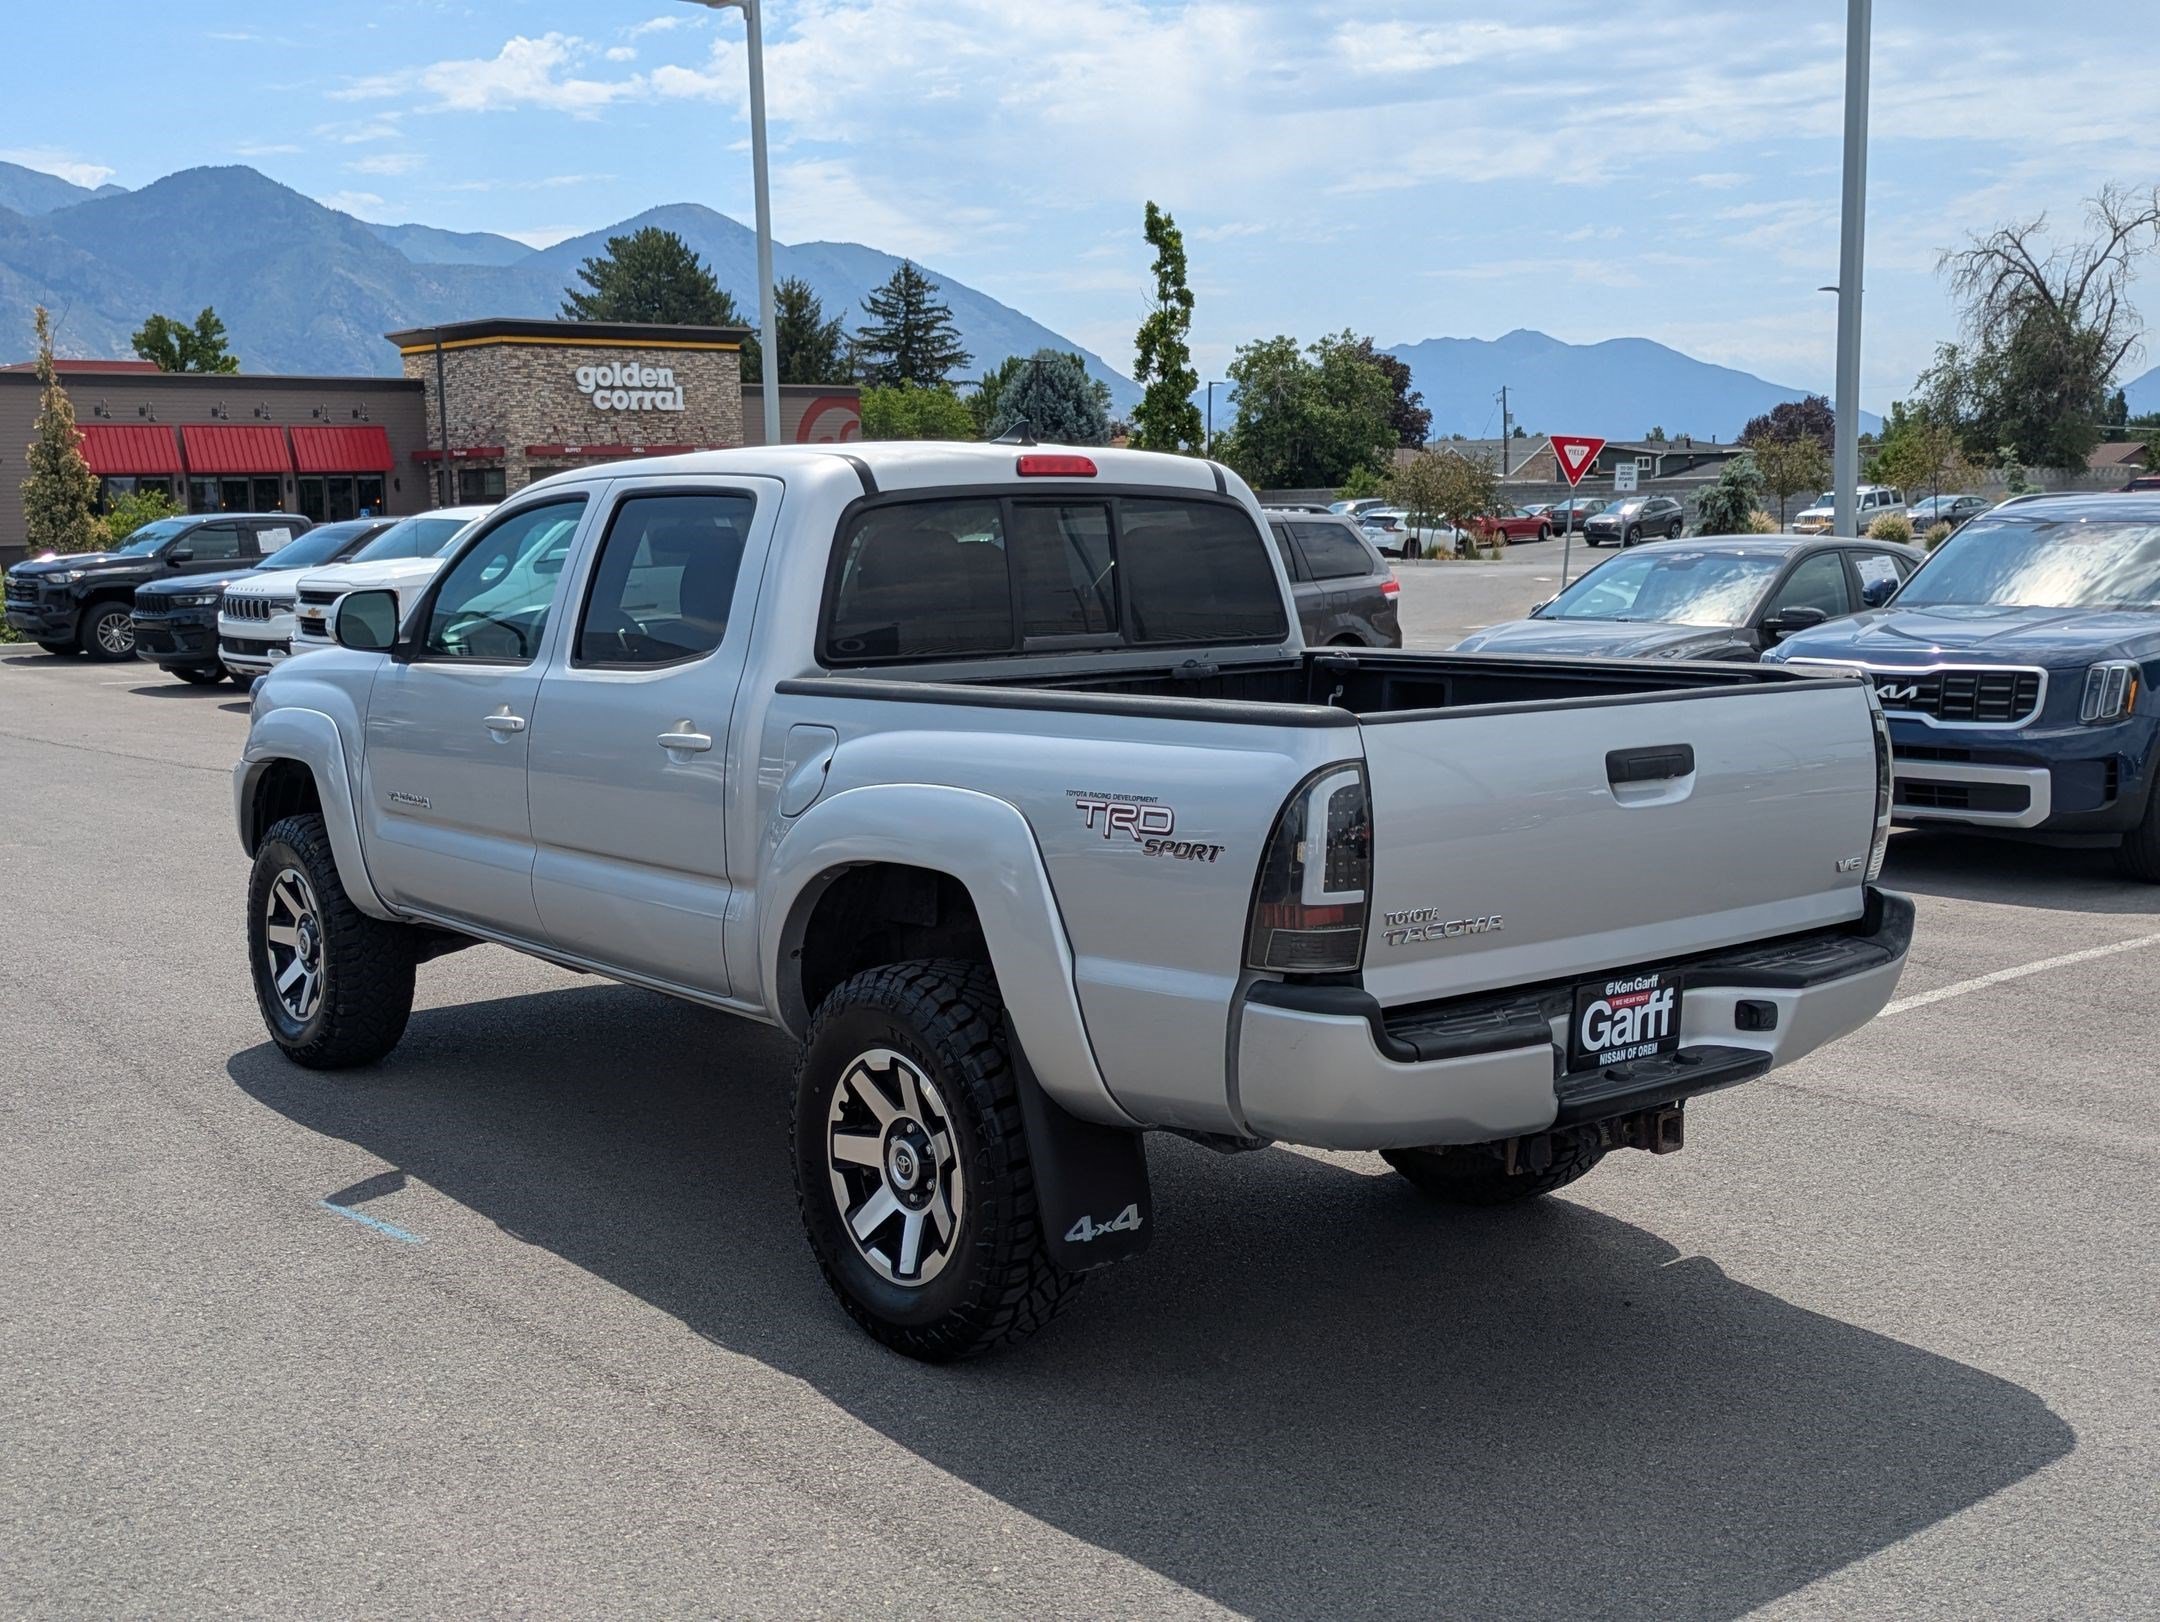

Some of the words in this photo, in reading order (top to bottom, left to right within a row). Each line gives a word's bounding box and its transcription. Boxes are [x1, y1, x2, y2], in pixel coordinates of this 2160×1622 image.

[576, 362, 675, 394] golden
[593, 386, 685, 411] corral
[1568, 448, 1585, 456] YIELD
[1066, 789, 1087, 798] TOYOTA
[1088, 791, 1112, 800] RACING
[1112, 793, 1159, 804] DEVELOPMENT
[1076, 799, 1175, 842] TRD
[1143, 838, 1225, 863] SPORT
[1385, 907, 1440, 926] TOYOTA
[1382, 915, 1504, 946] TACOMA
[1581, 987, 1674, 1051] Garff
[1600, 1050, 1626, 1066] NISSAN
[1627, 1046, 1637, 1059] OF
[1638, 1042, 1658, 1056] OREM
[1064, 1203, 1144, 1242] 4x4
